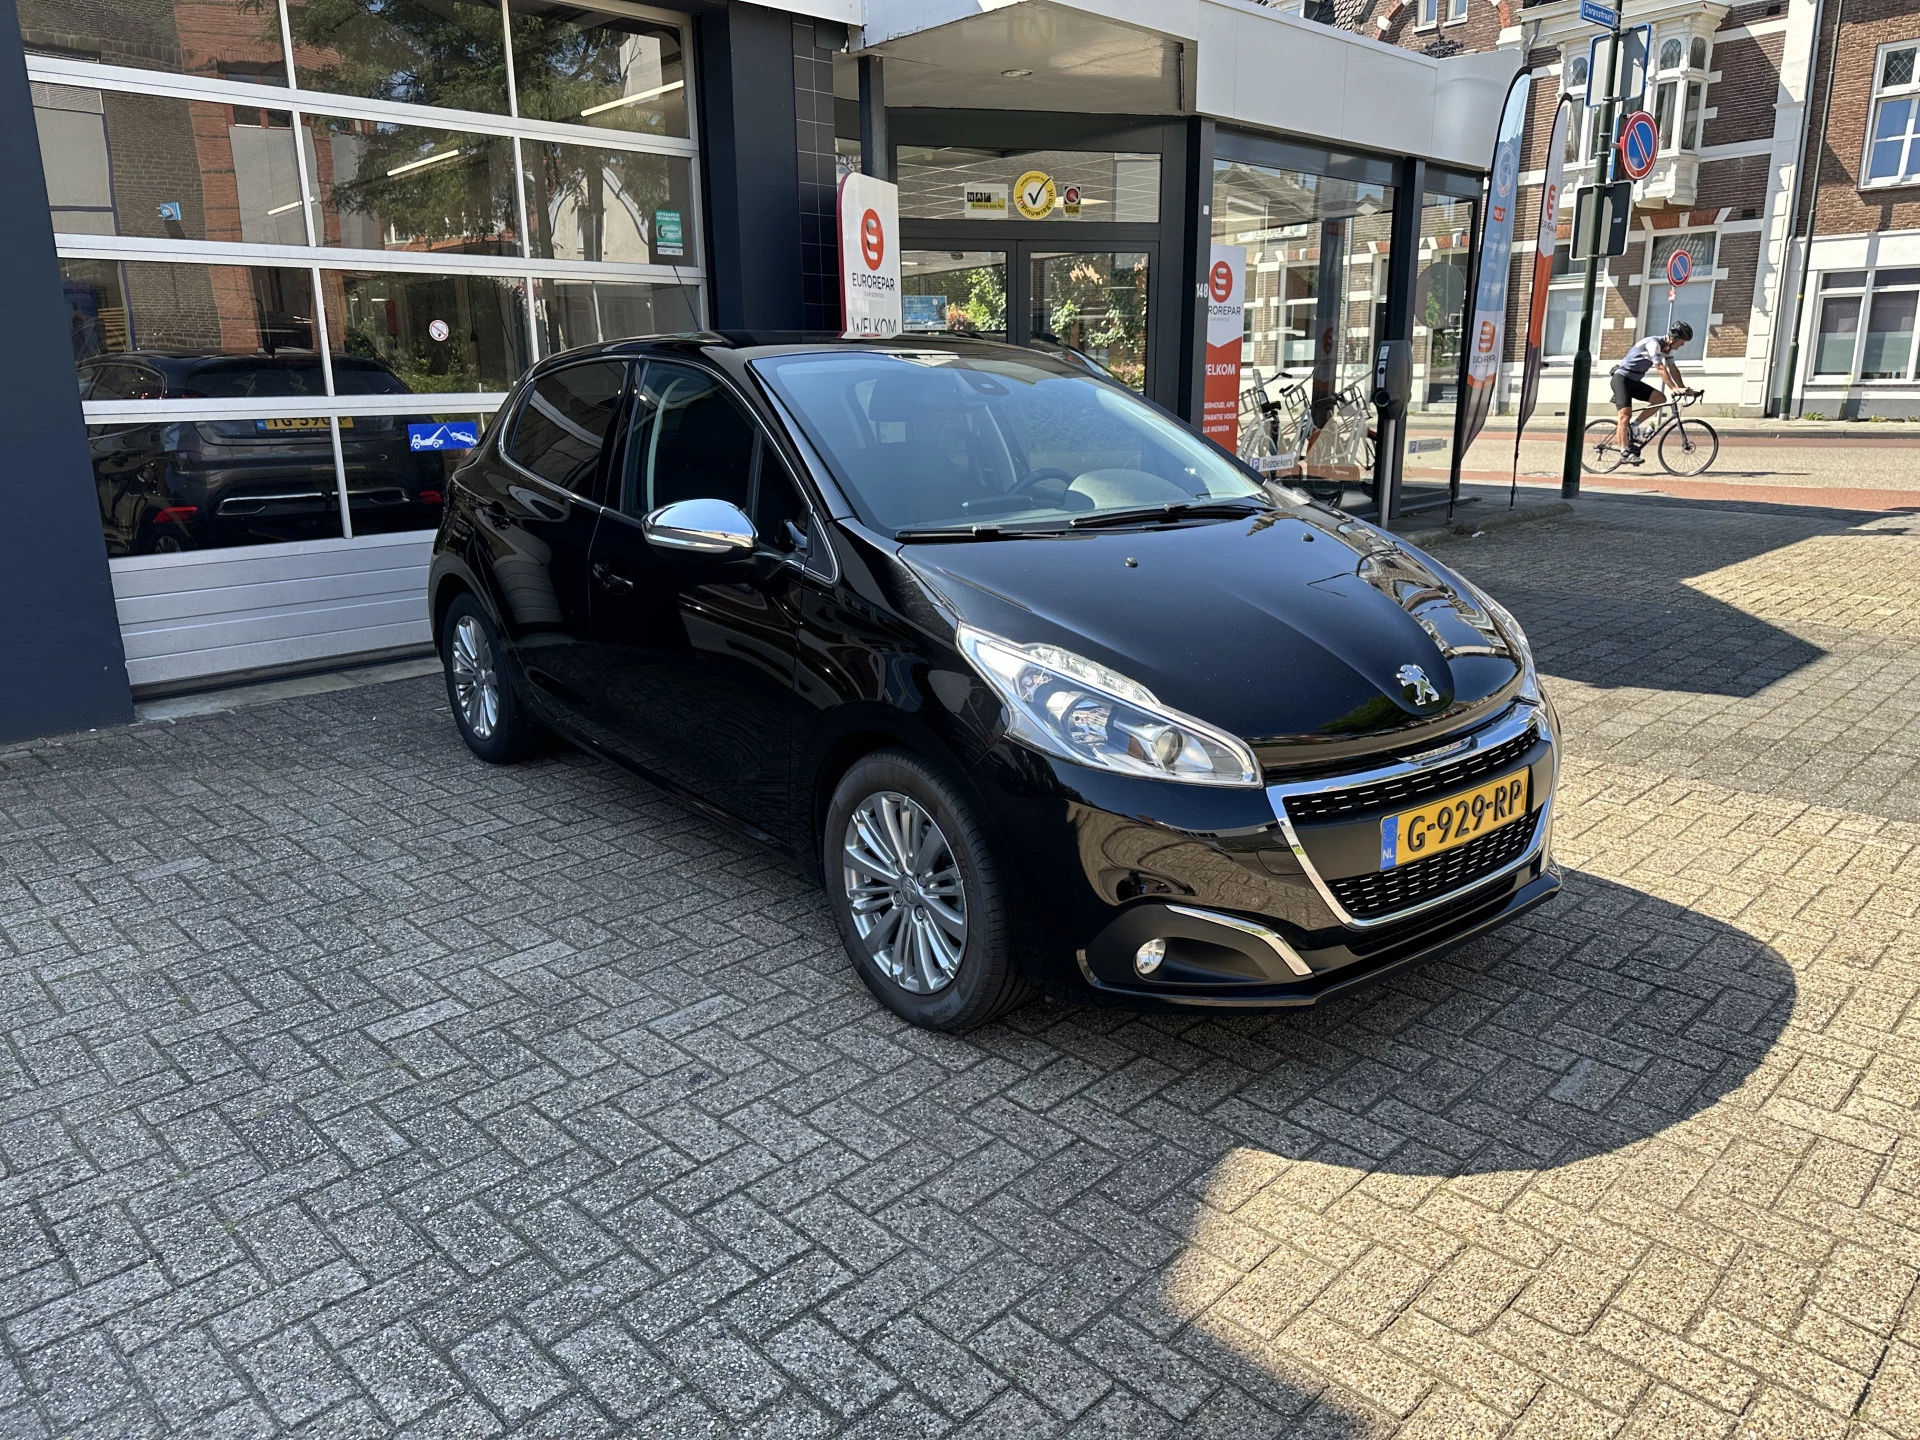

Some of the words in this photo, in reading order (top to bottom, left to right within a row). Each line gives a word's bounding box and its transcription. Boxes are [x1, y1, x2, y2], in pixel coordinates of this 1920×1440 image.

[852, 272, 895, 291] EUROREPAR
[1196, 282, 1209, 298] 148
[1208, 305, 1241, 315] ROREPAR
[1206, 363, 1236, 376] ELKOM
[1263, 457, 1292, 469] Bezoekers
[1407, 779, 1523, 852] G-929-RP
[1382, 847, 1395, 861] NL
